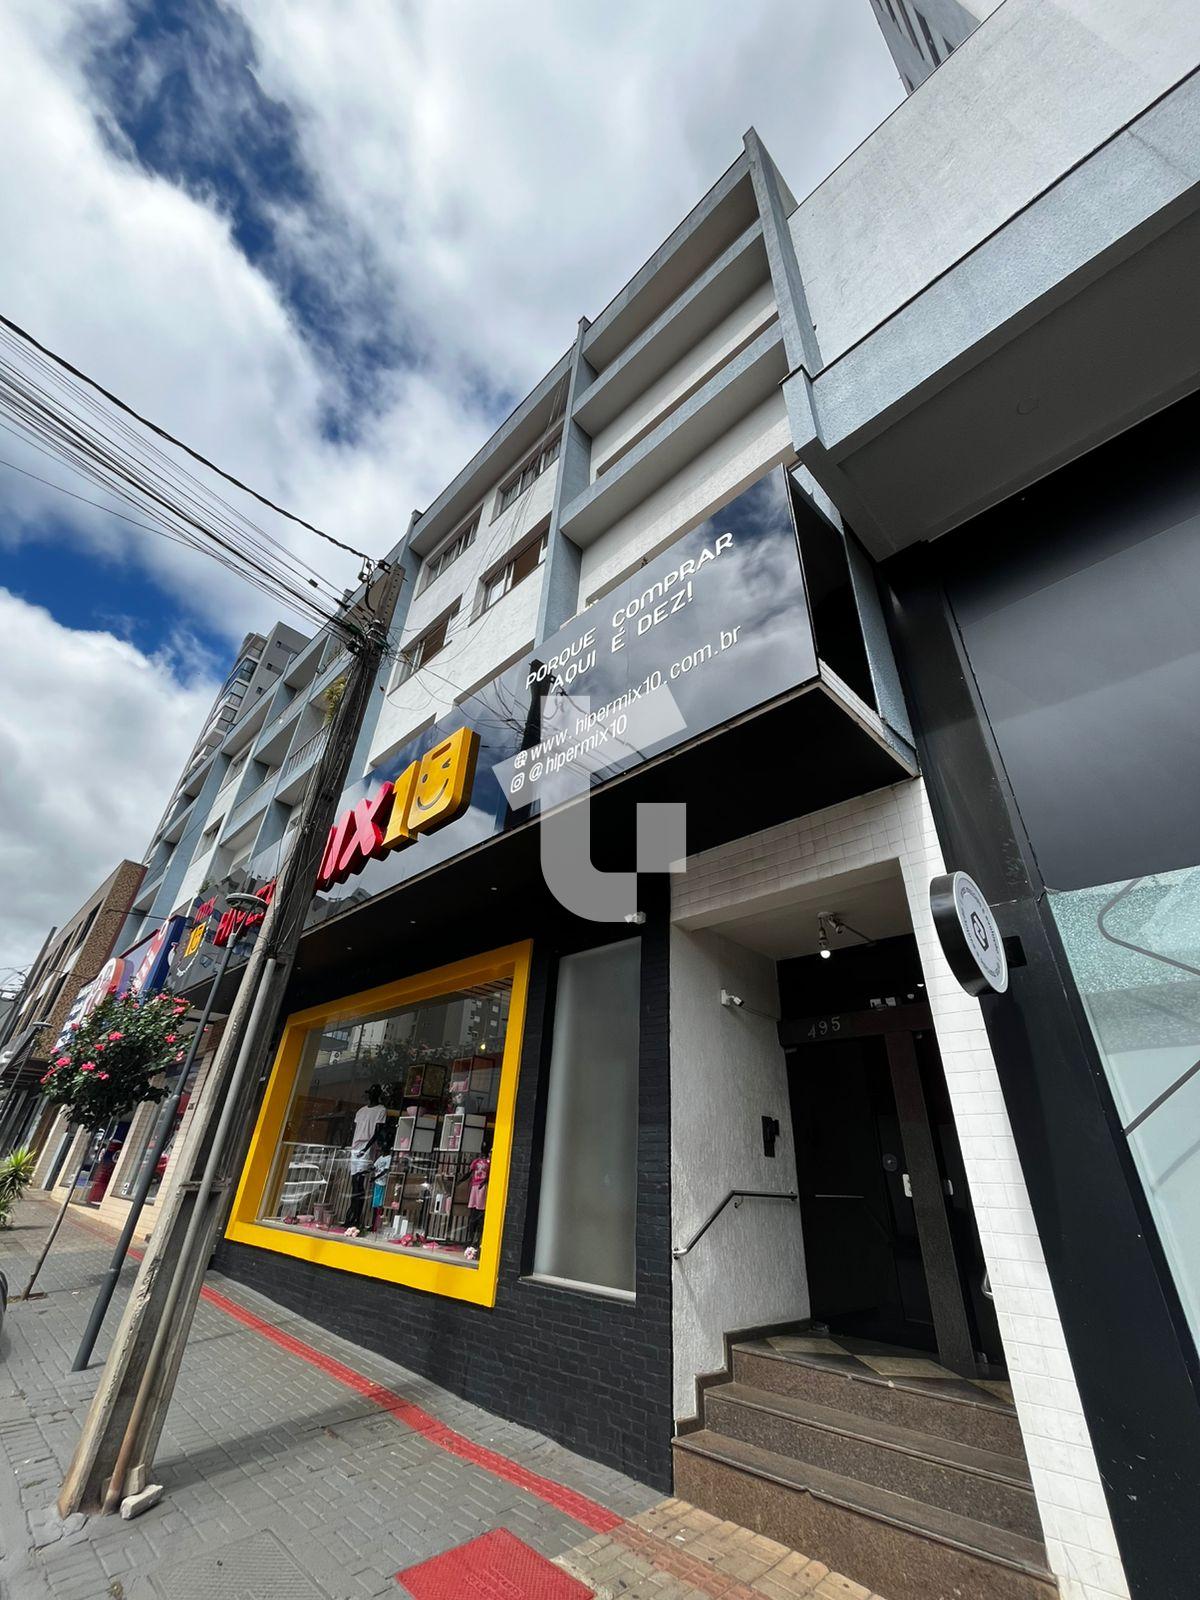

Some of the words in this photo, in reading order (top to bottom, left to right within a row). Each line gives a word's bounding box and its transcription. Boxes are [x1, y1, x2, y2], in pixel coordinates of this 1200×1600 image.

[525, 627, 597, 690] PORQUE
[612, 532, 734, 628] COMPRAR
[551, 650, 597, 693] AQUI
[611, 627, 626, 653] É
[637, 580, 693, 637] DEZ!
[807, 1015, 841, 1038] 495
